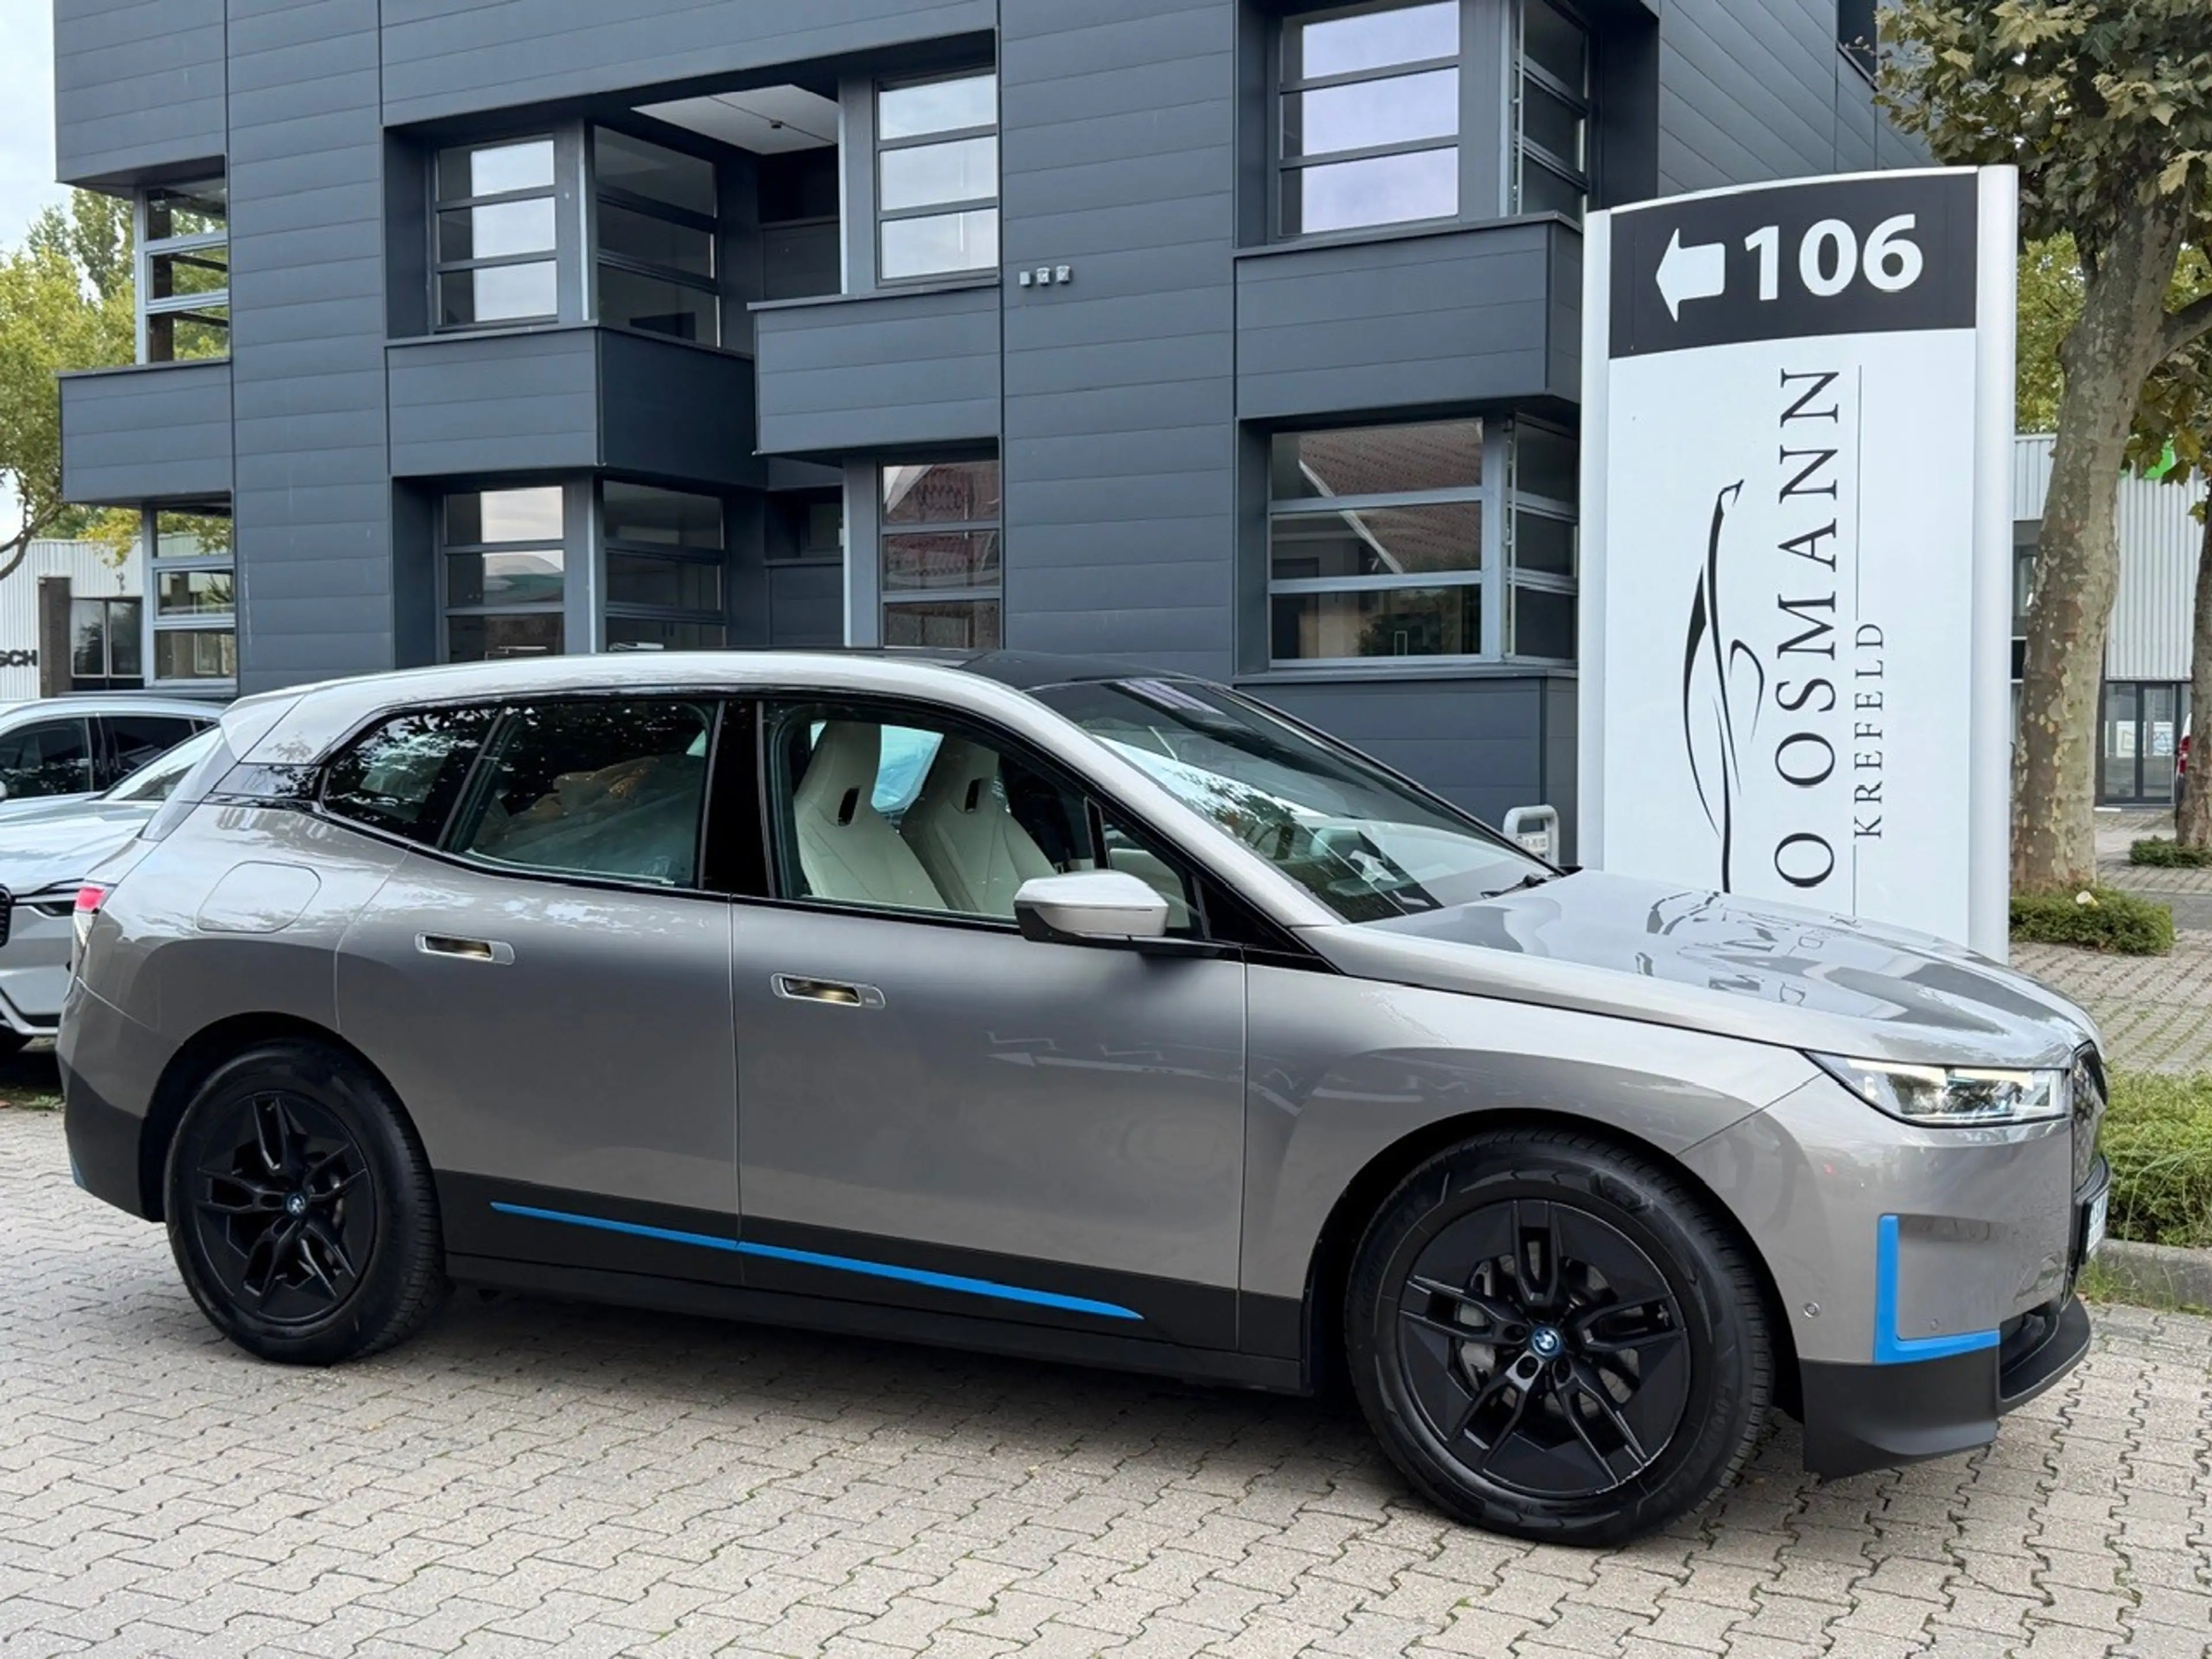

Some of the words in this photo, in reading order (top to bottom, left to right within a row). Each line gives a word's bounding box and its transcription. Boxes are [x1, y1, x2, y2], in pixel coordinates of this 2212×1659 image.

[1744, 213, 1923, 301] 106
[1775, 368, 1839, 788] OSMANN
[1854, 624, 1883, 838] KREFELD
